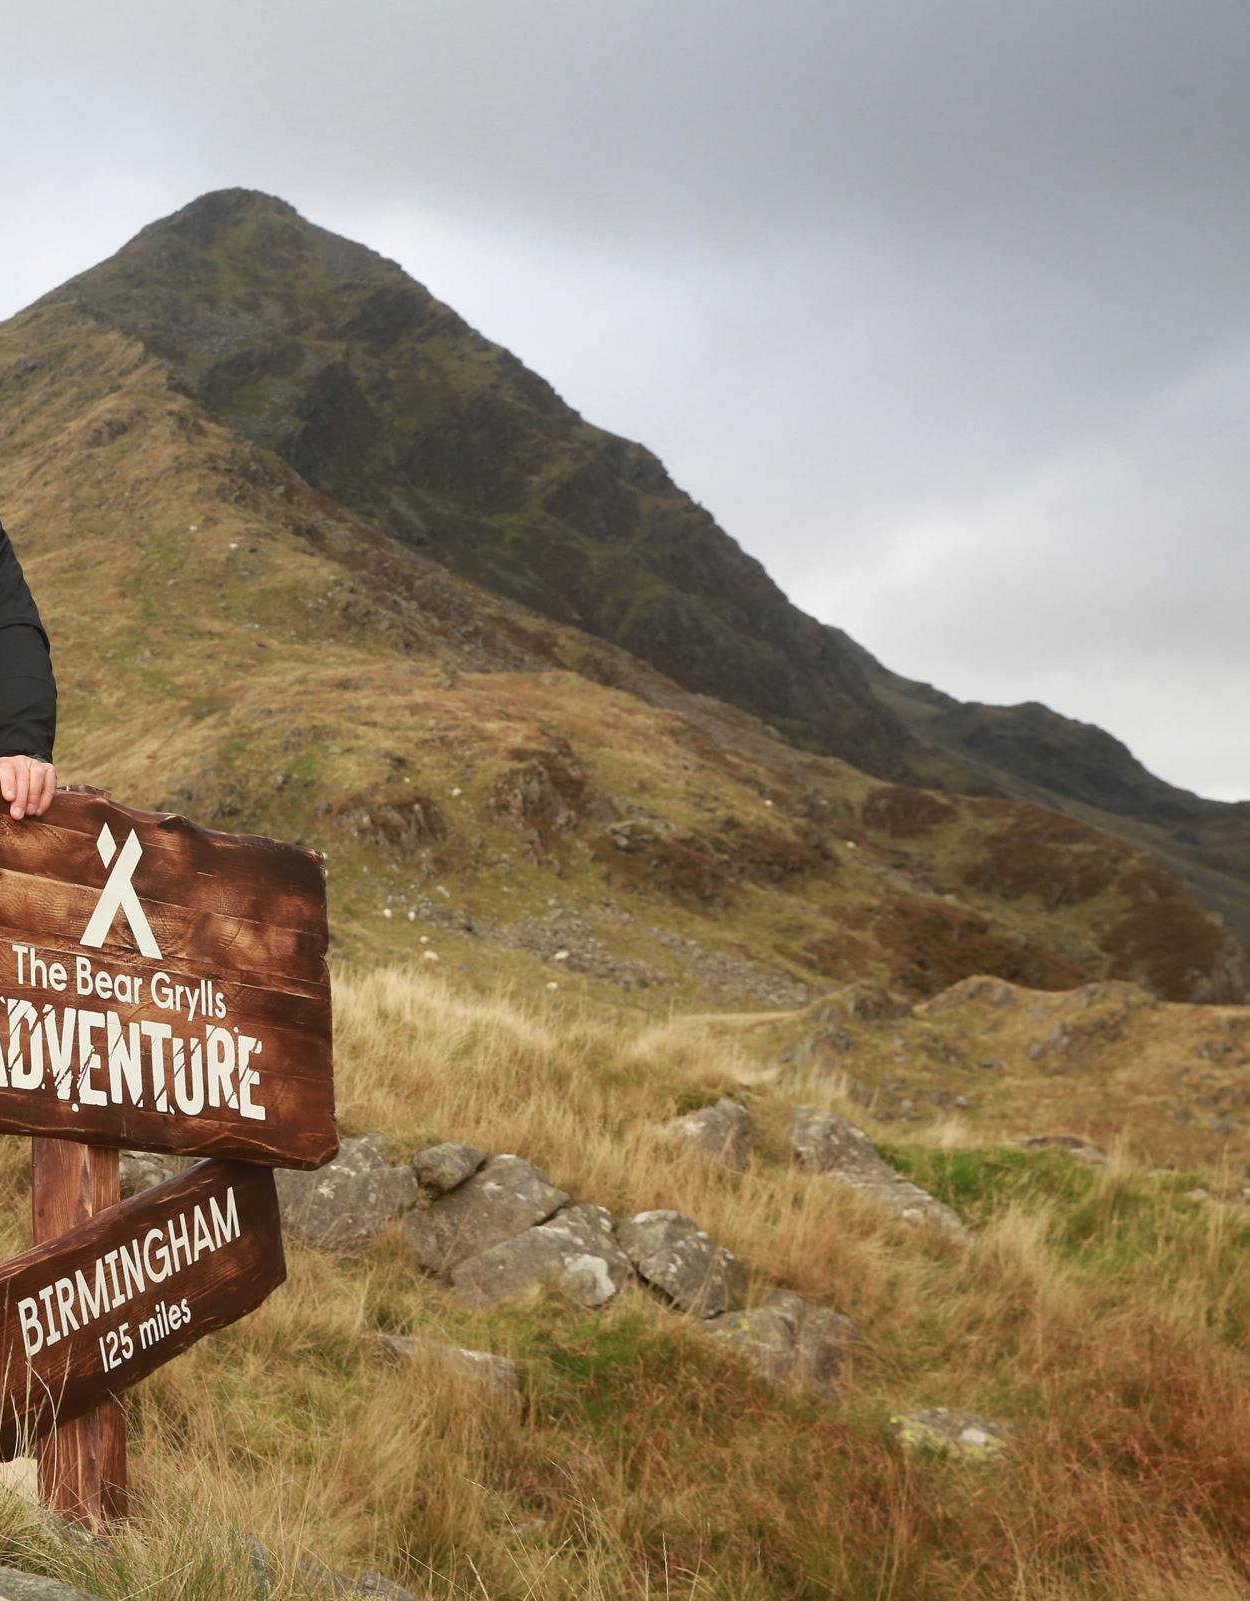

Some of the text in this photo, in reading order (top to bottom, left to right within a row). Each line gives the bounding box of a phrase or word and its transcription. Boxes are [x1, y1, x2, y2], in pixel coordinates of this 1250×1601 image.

[11, 944, 227, 1022] The Bear Grylls
[17, 1186, 241, 1358] BIRMINGHAM
[98, 1298, 191, 1373] 125 miles
